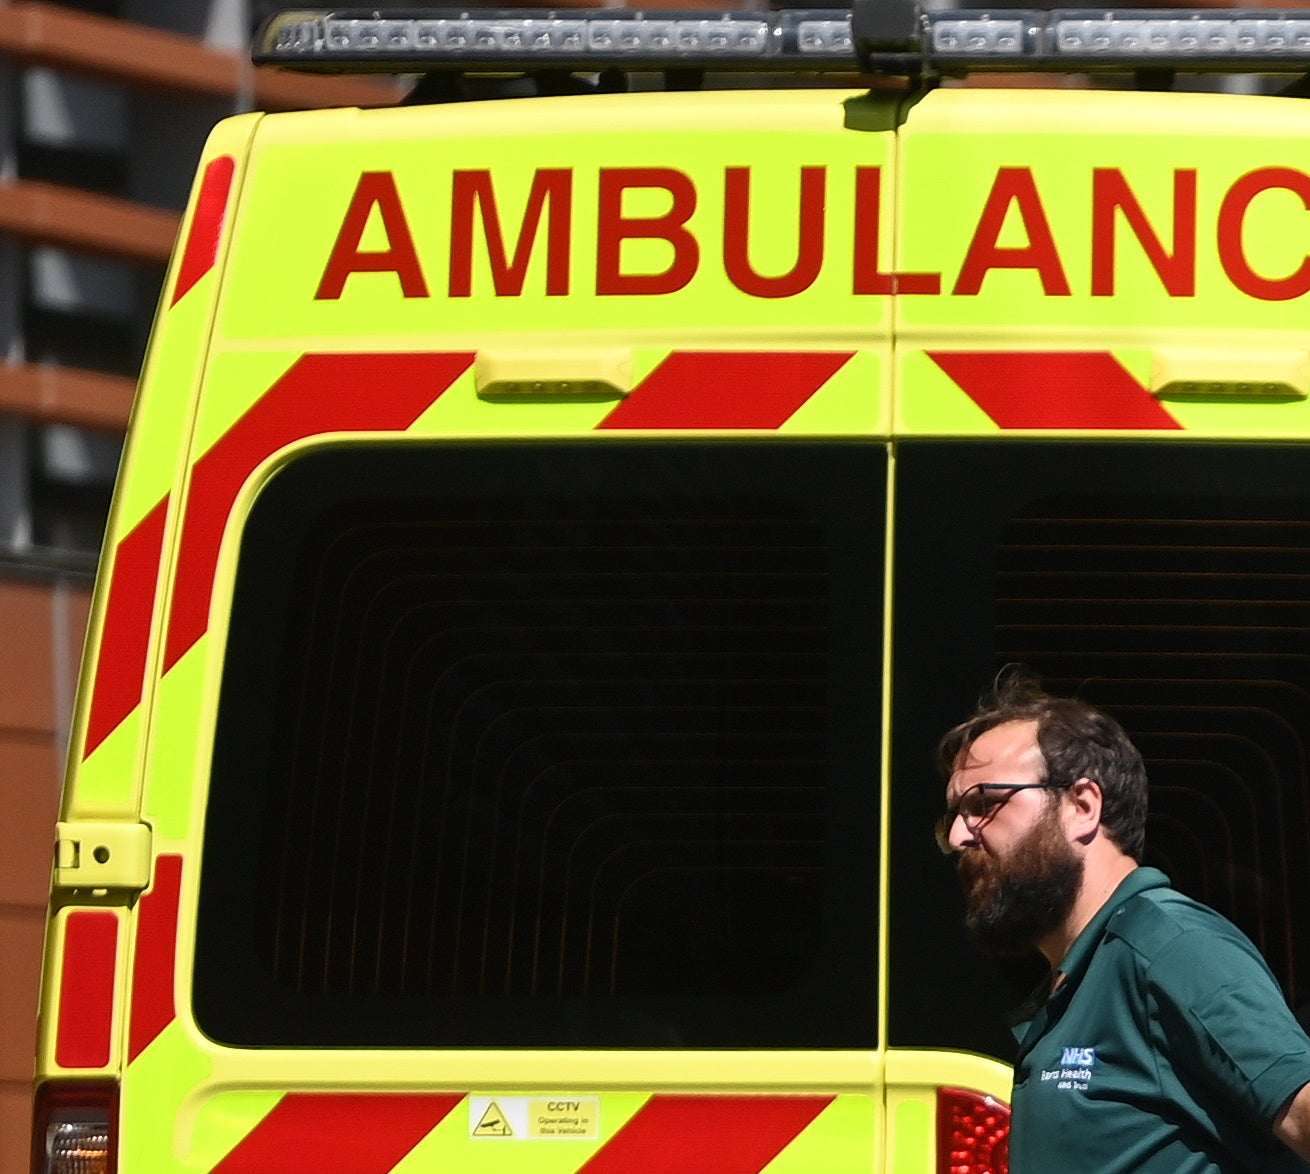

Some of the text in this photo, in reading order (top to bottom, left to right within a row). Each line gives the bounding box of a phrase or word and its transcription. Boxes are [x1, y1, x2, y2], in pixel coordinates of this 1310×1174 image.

[1060, 1046, 1094, 1067] NHS
[1061, 1067, 1092, 1080] Health
[547, 1101, 580, 1112] CCTV
